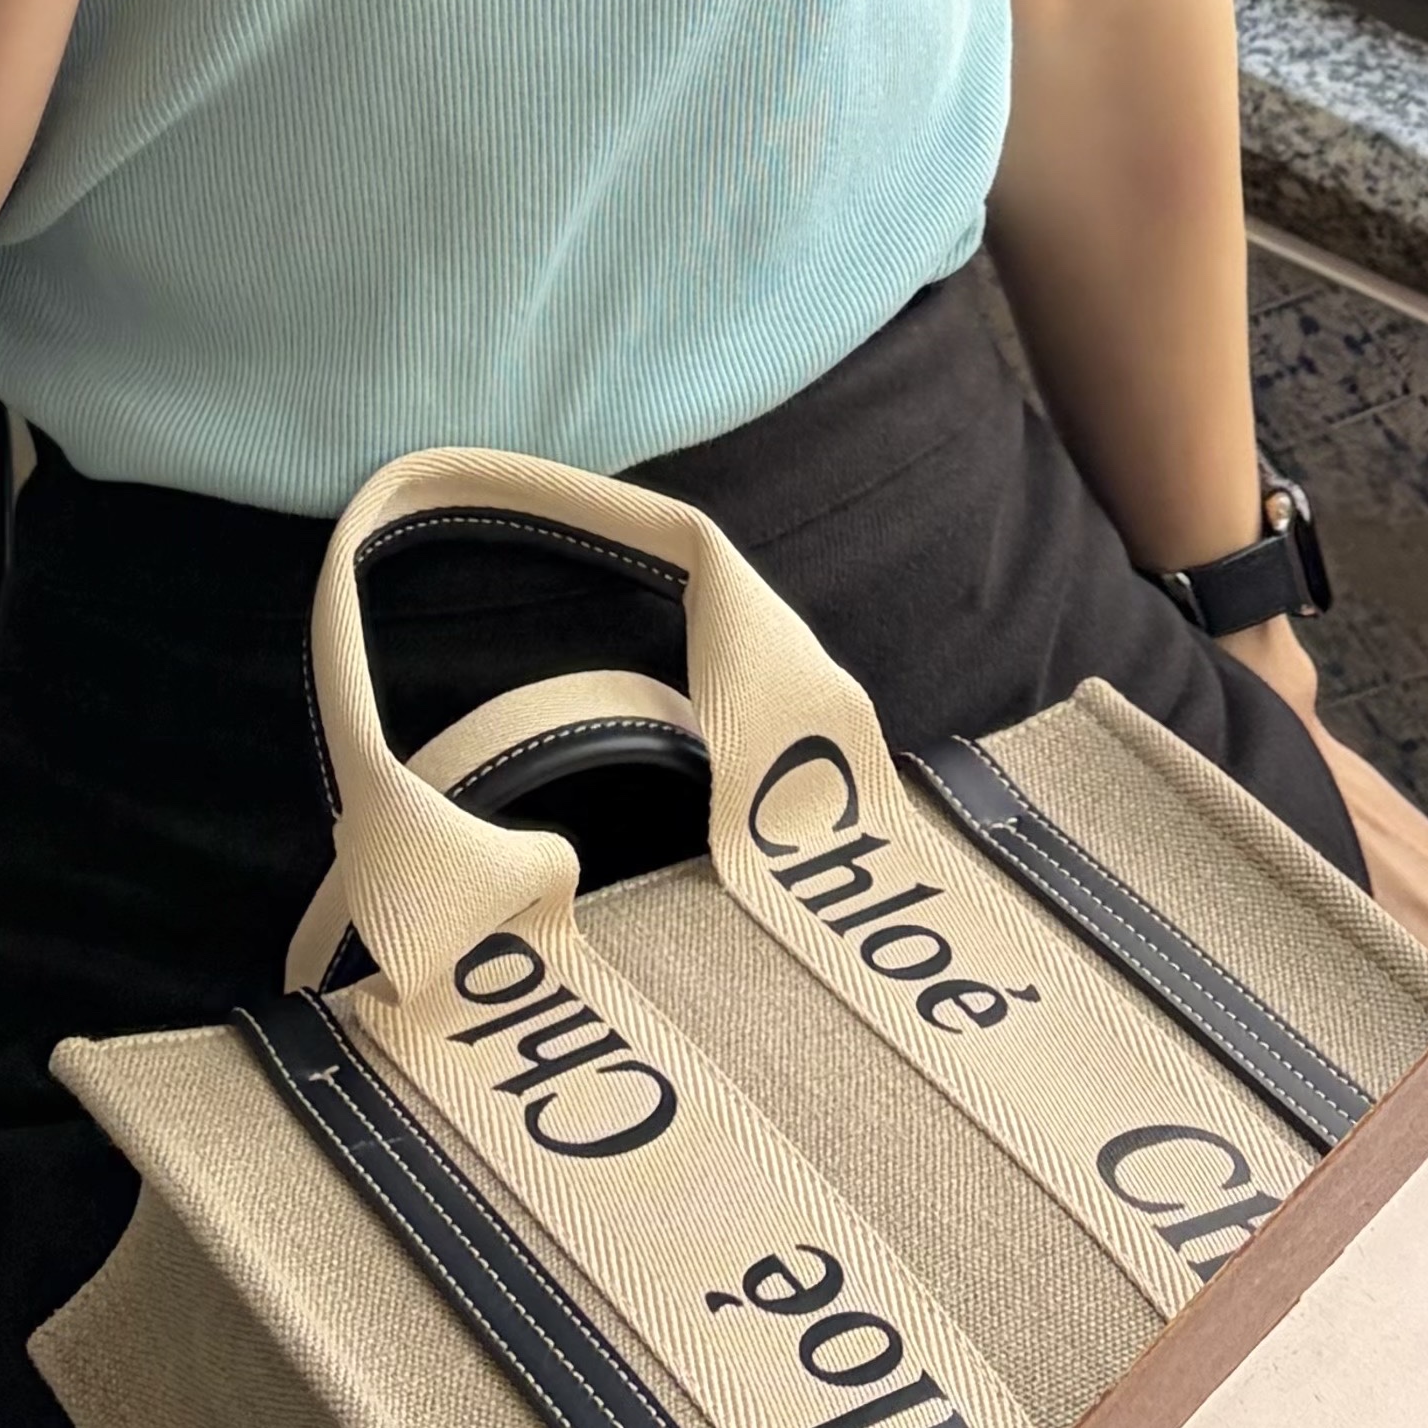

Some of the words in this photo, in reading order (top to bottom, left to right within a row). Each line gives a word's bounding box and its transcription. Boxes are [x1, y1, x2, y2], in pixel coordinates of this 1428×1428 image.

[748, 734, 1041, 1034] Chloé
[445, 931, 678, 1158] Chlo
[704, 1243, 969, 1428] loé
